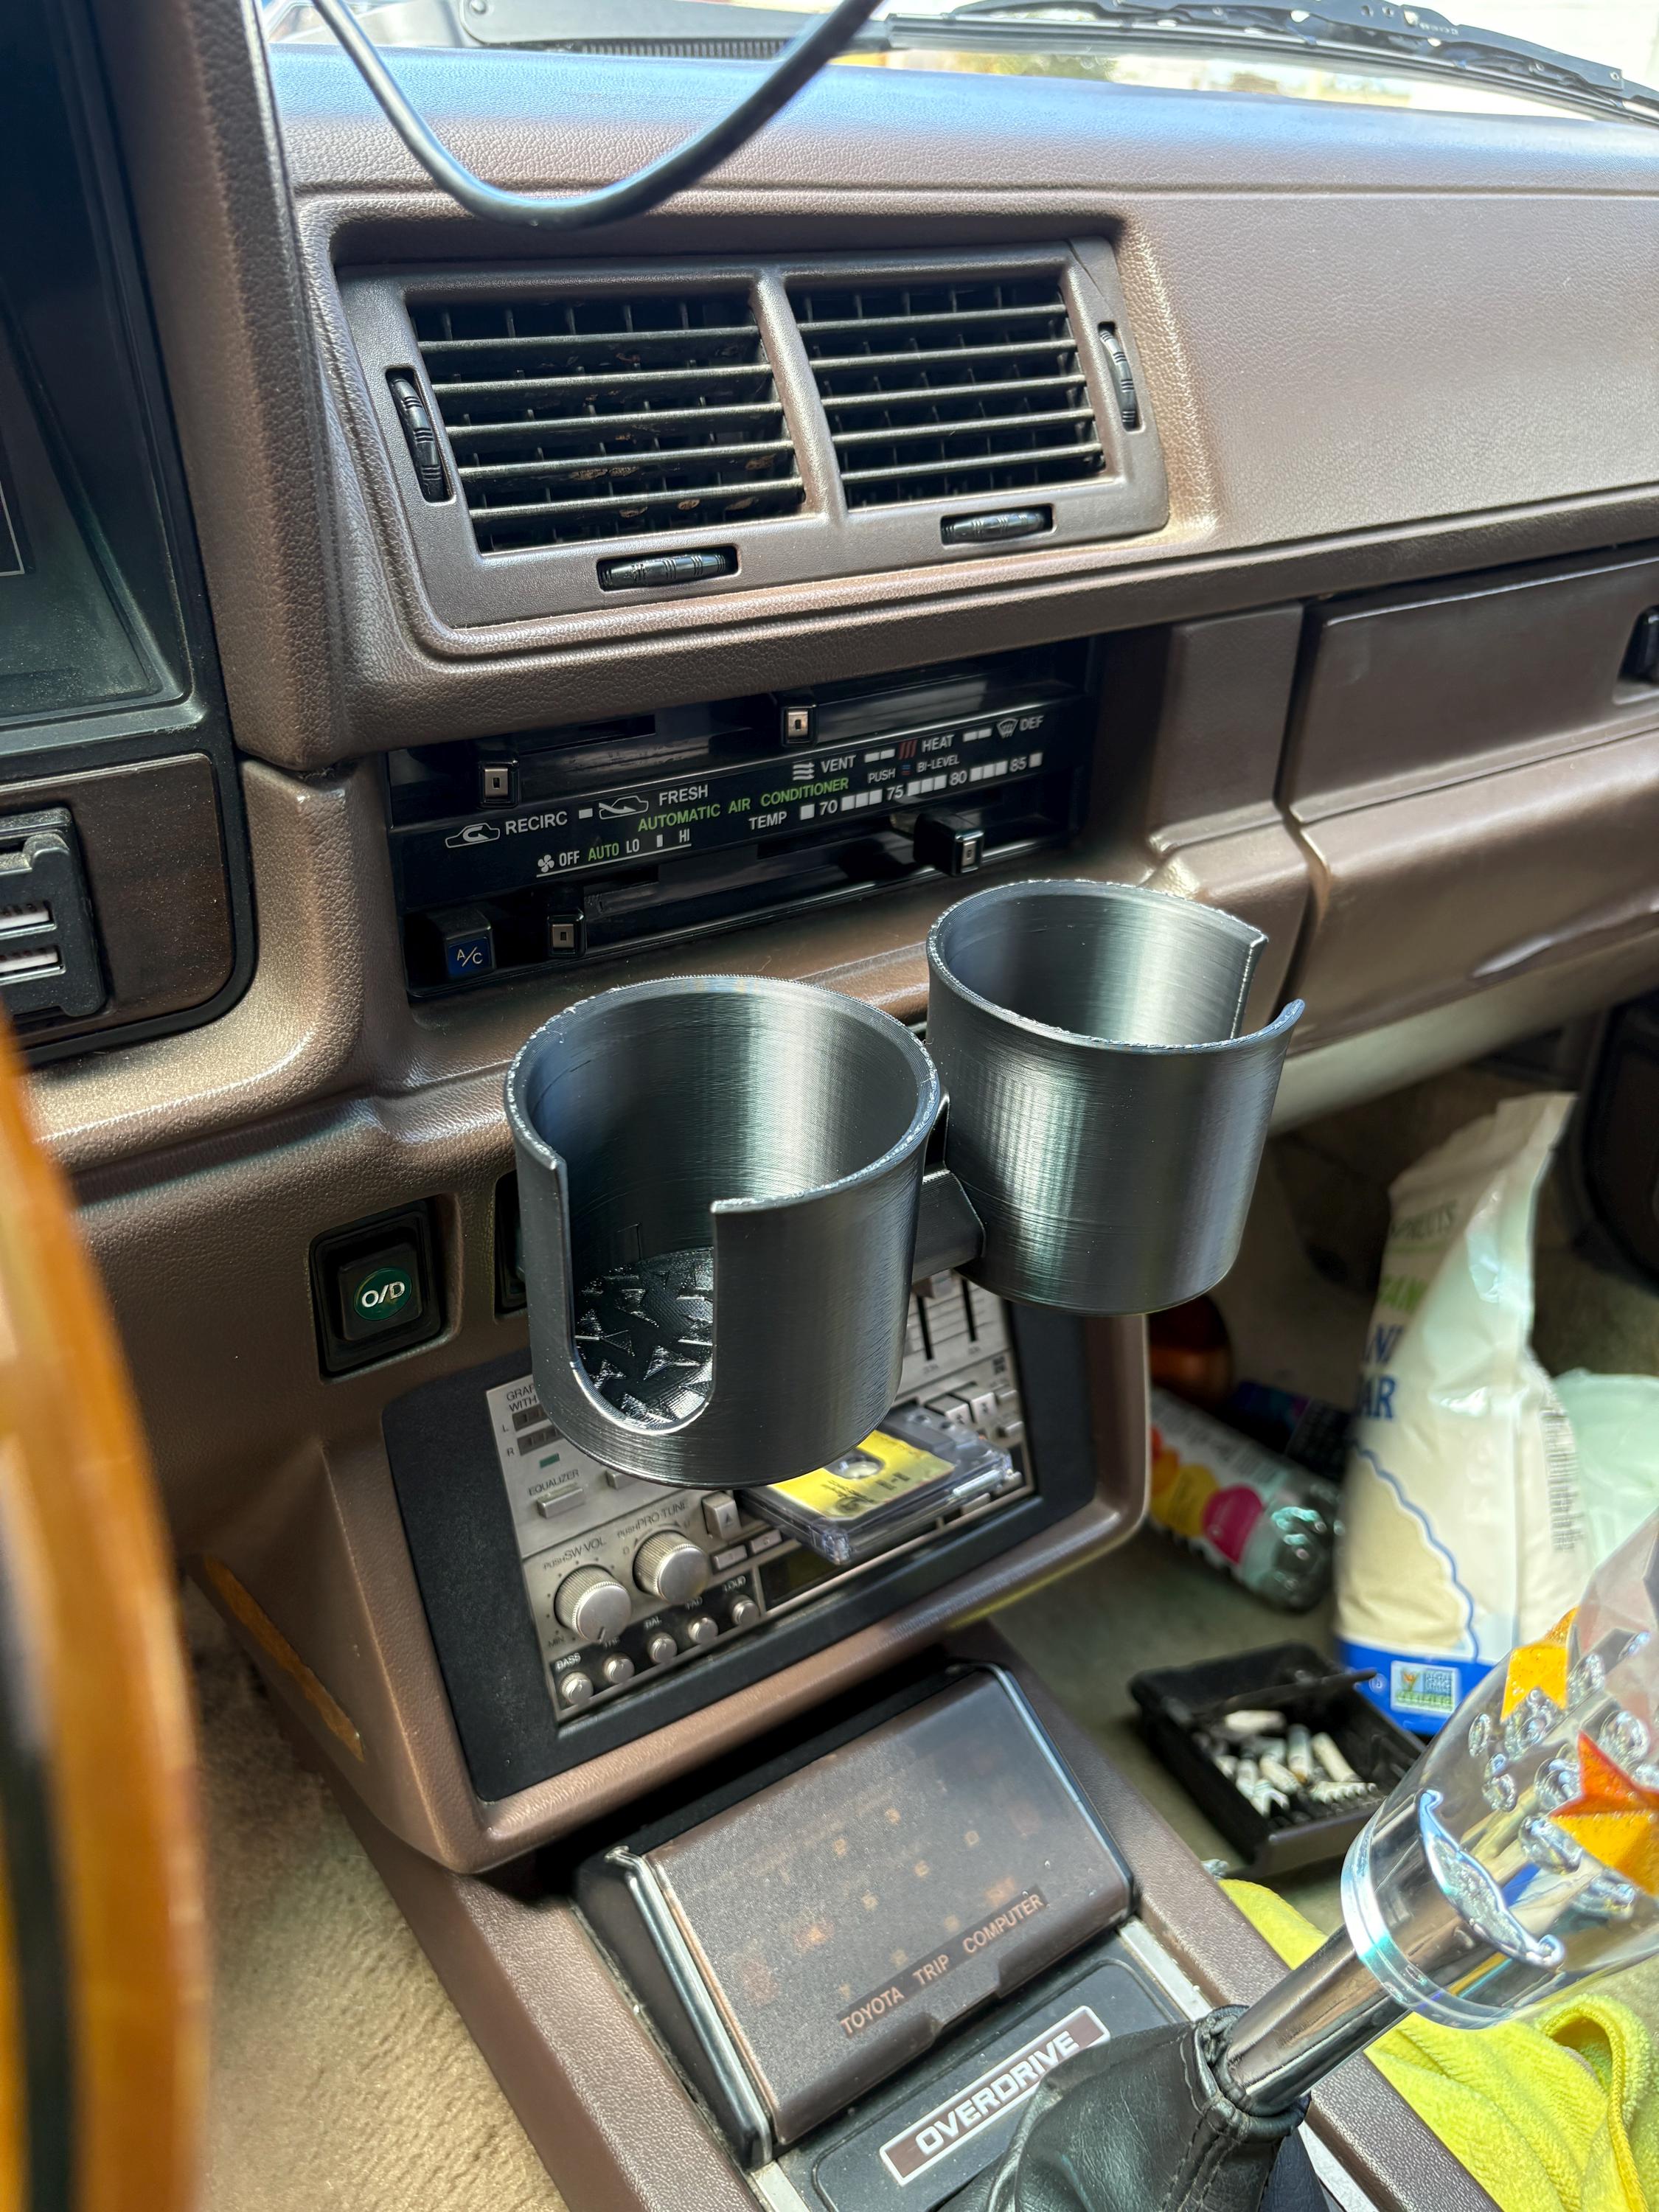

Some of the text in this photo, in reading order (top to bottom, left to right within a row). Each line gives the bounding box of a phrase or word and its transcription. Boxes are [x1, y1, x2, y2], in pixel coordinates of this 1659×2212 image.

[1019, 715, 1044, 732] DEF
[922, 734, 955, 752] HEAT
[821, 755, 856, 773] VENT
[867, 754, 960, 784] PUSH BI-LEVEL
[659, 785, 708, 806] FRESH
[749, 757, 1027, 830] TEMP 70 75 80 85
[637, 778, 849, 832] AUTOMATIC AIR CONDITIONER
[505, 811, 568, 835] RECIRC
[559, 830, 690, 866] OFF AUTO LO HI
[456, 948, 483, 967] A/C
[361, 1281, 406, 1308] O/D
[509, 1394, 538, 1412] WITH
[502, 1424, 509, 1433] L
[507, 1447, 515, 1458] R
[529, 1468, 580, 1496] EQUALIZER
[555, 1652, 581, 1670] BASS
[840, 1986, 905, 2037] TOYOTA
[912, 1954, 950, 1986] TRIP
[961, 1893, 1045, 1954] COMPUTER
[915, 2030, 1079, 2157] OVERDRIVE
